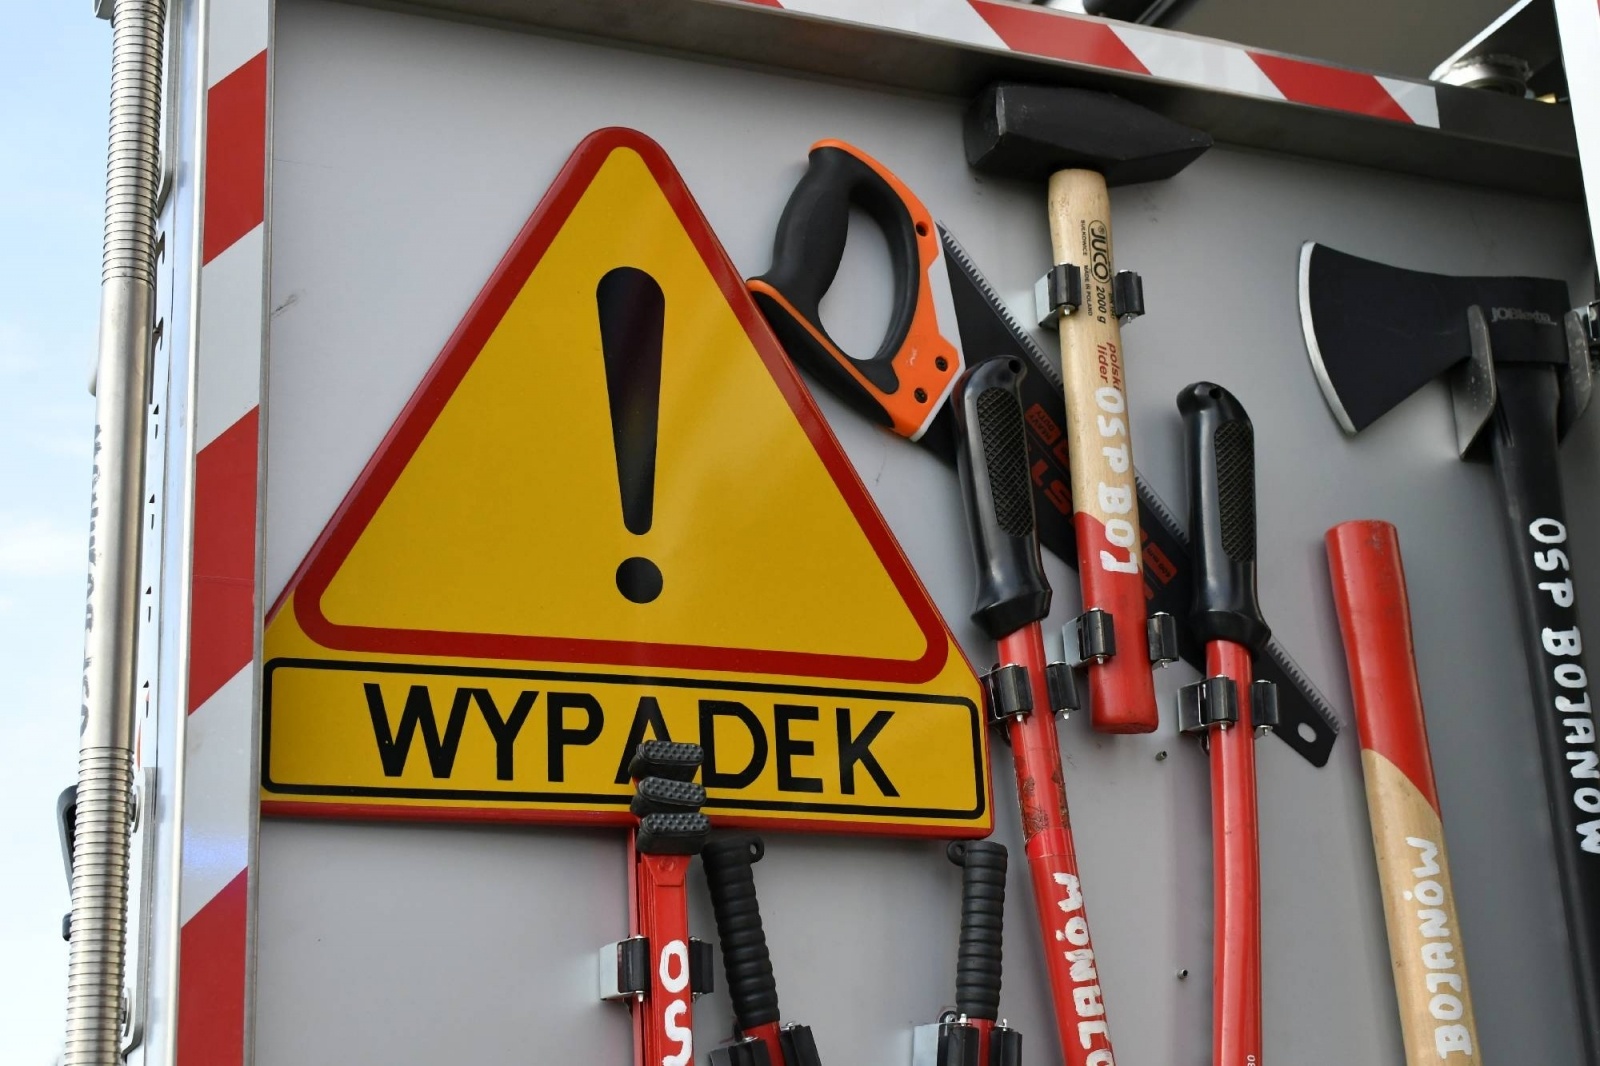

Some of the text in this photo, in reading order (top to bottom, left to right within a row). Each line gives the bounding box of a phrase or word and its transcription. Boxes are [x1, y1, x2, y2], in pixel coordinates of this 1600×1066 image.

[1091, 228, 1110, 324] JUCO 2000 g
[1097, 344, 1109, 384] lider
[1106, 342, 1122, 392] polski
[1095, 387, 1130, 473] OSP
[1529, 517, 1574, 608] OSP
[1404, 836, 1472, 1060] BOJANÓW
